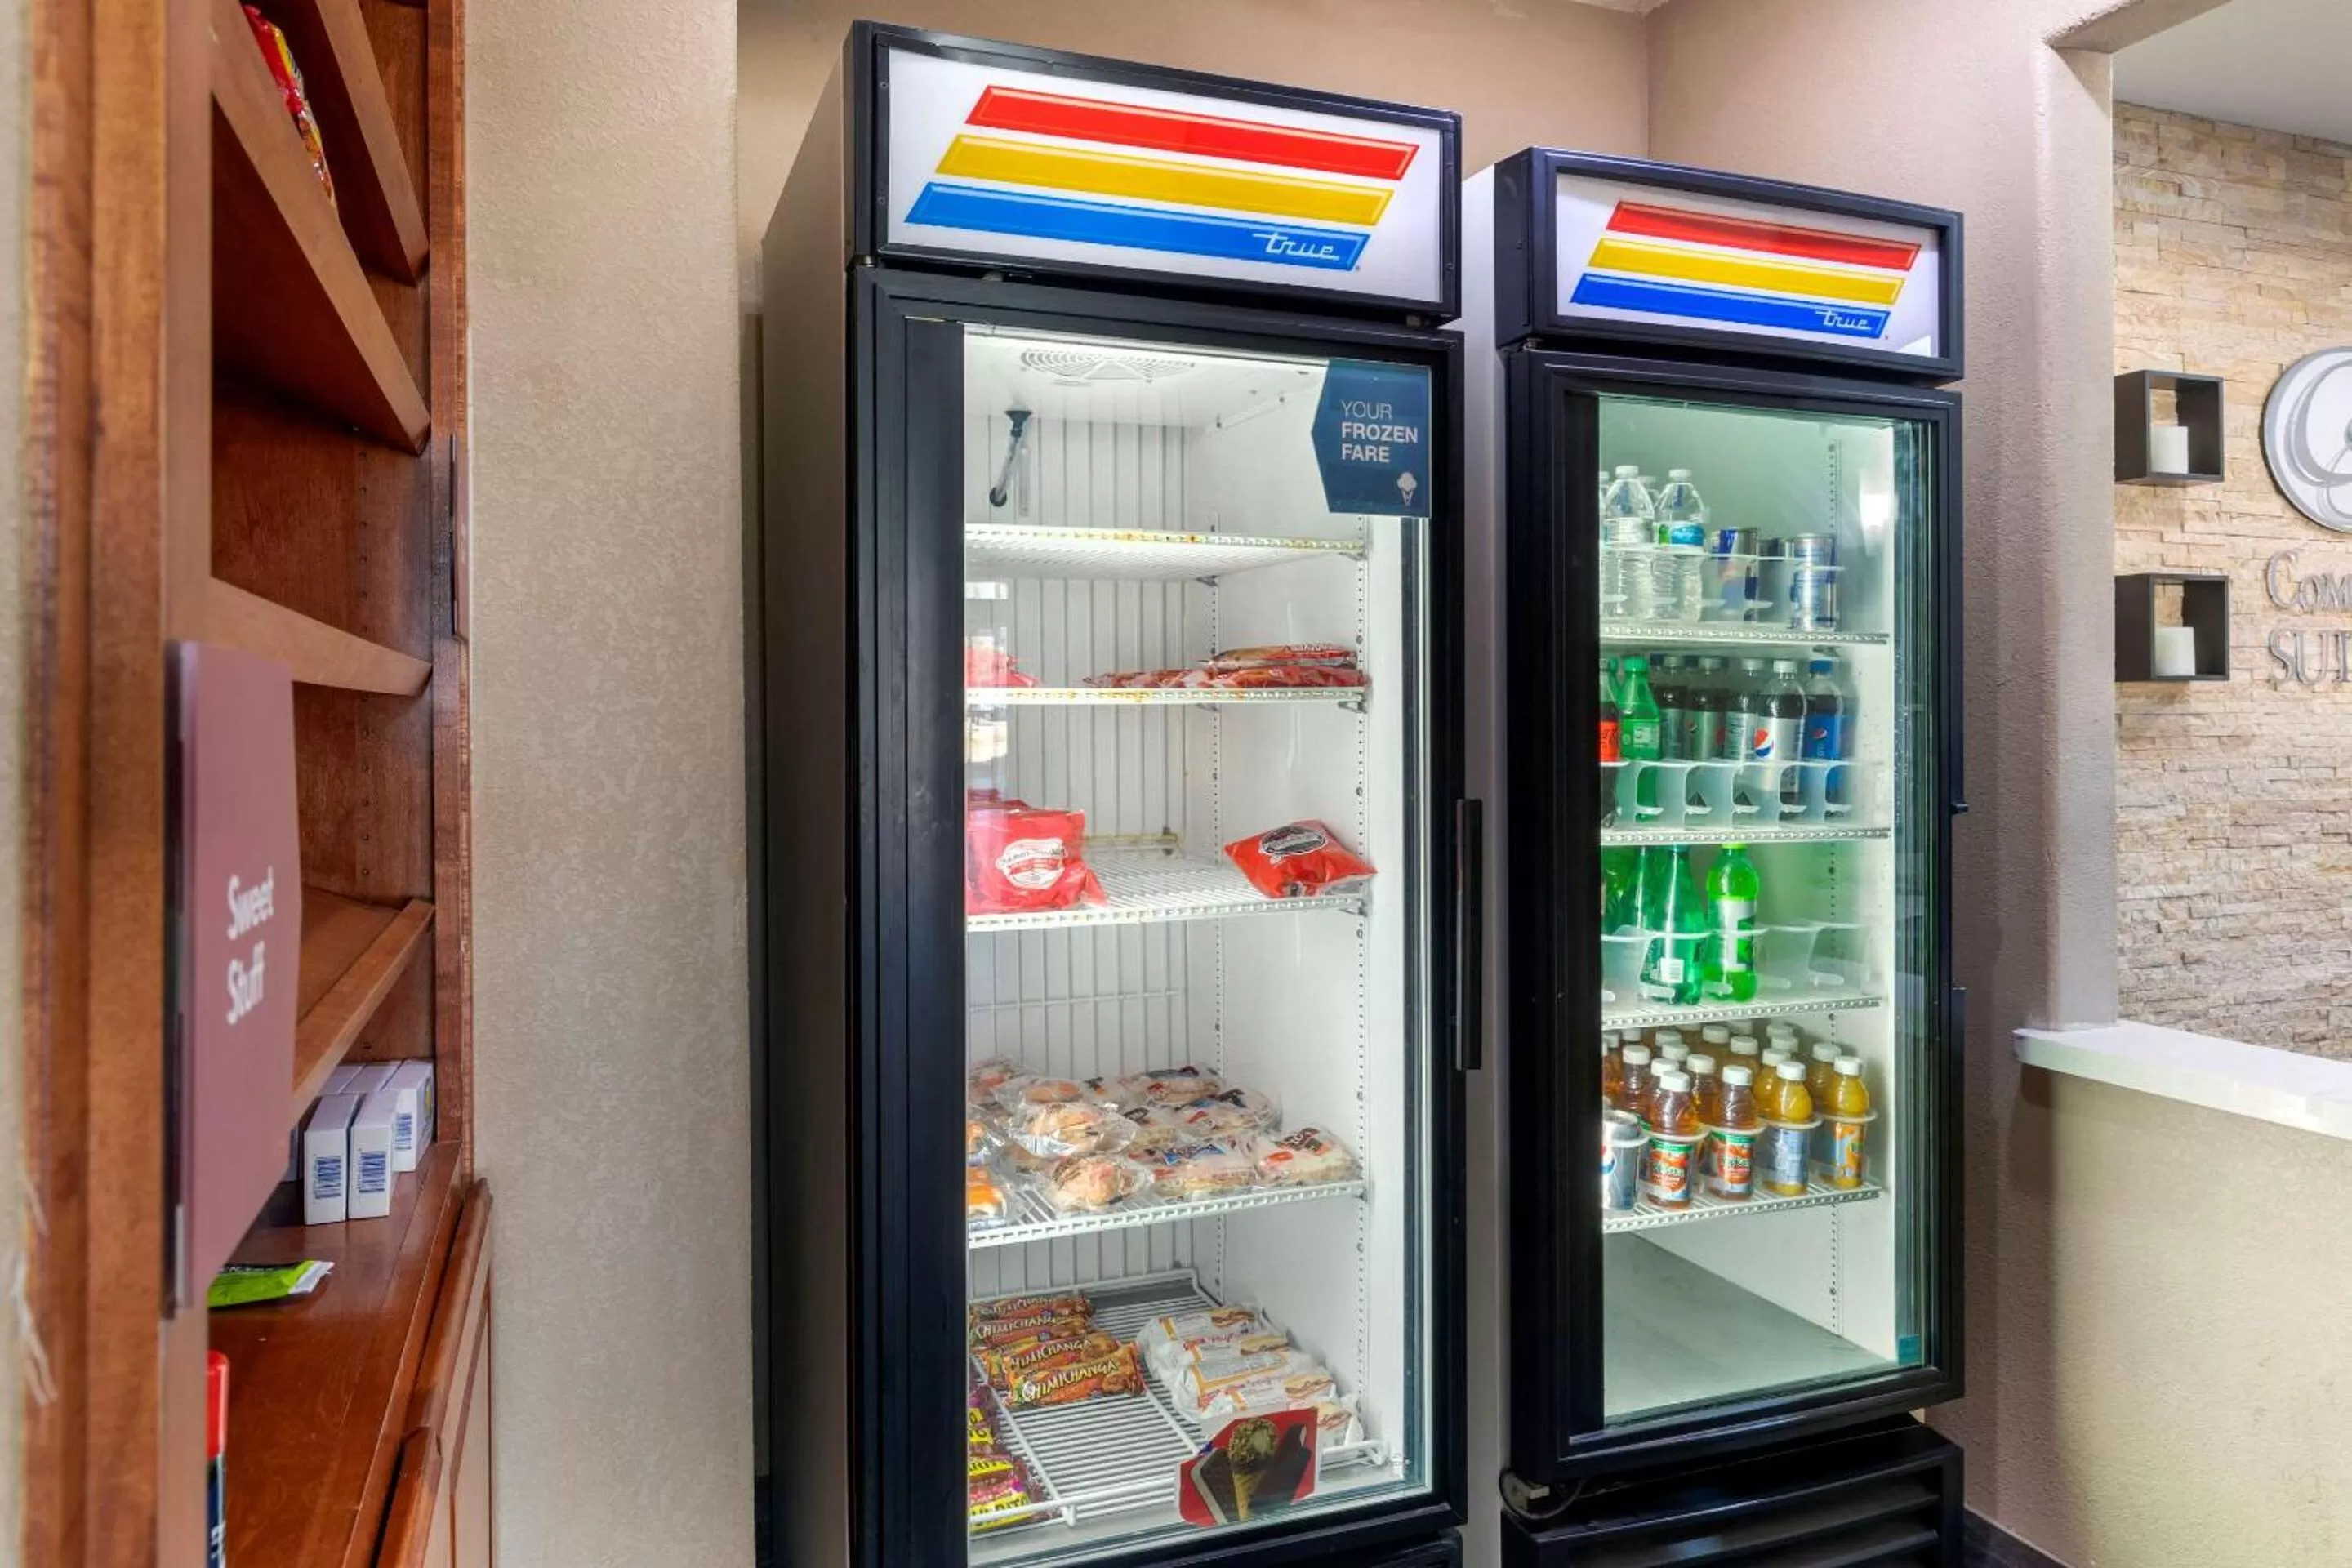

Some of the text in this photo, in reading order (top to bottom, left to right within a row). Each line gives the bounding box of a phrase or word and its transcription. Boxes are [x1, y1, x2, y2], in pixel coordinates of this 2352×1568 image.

[1253, 232, 1340, 261] true
[1341, 399, 1393, 421] YOUR
[1341, 421, 1419, 443] FROZEN
[1341, 443, 1391, 463] FARE
[227, 865, 274, 941] Sweet
[226, 940, 265, 1026] Stuff
[1009, 1339, 1092, 1371] HIMICHANGA
[1021, 1359, 1118, 1402] CHIMICHANGA
